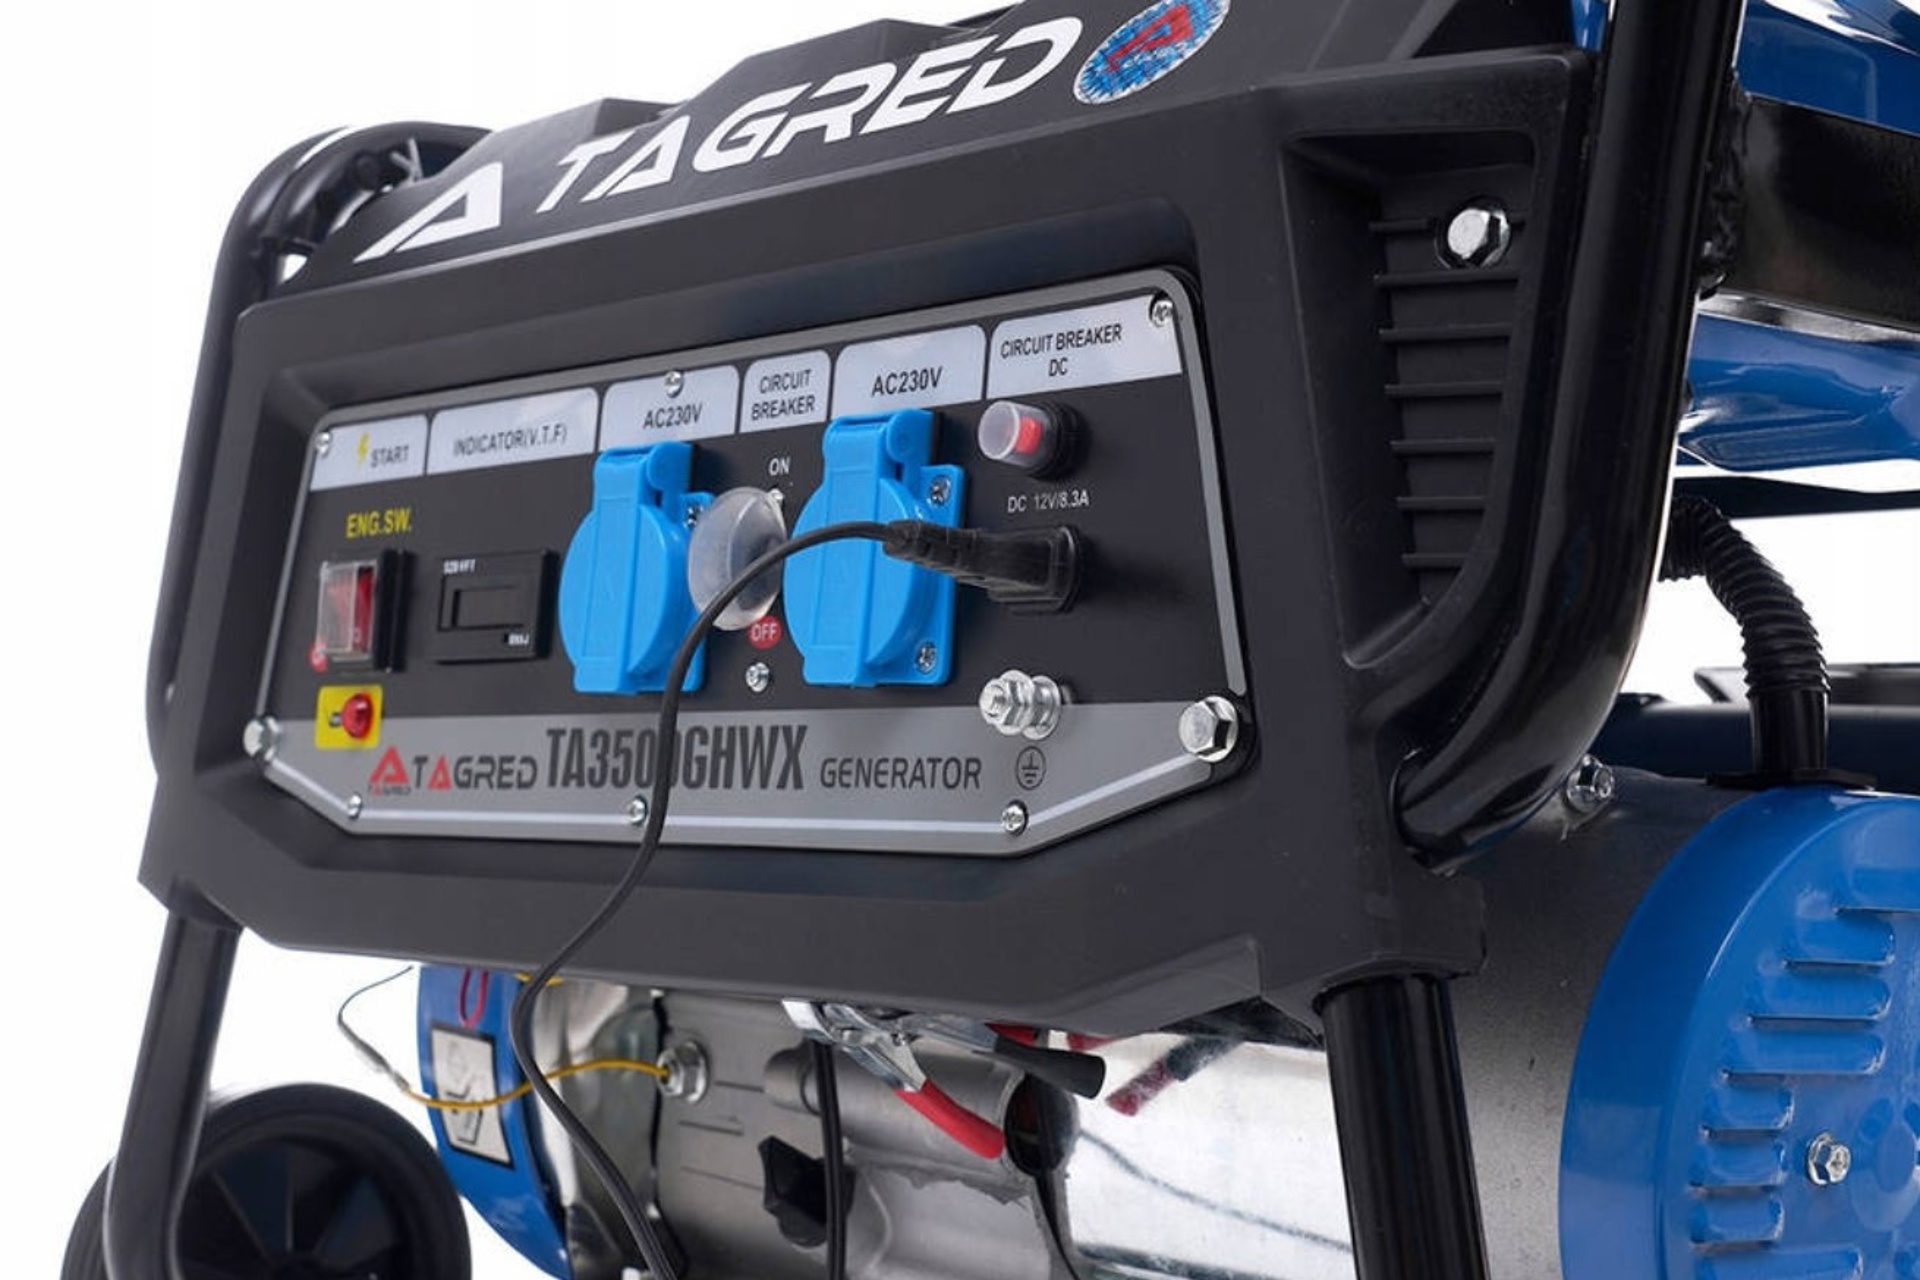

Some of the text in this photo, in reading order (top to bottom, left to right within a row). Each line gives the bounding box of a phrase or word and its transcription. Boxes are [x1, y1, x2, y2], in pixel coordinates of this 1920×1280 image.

[536, 16, 1083, 213] TAGRED
[1001, 323, 1122, 358] CIRCUIT BREAKER
[1048, 357, 1069, 377] DC
[759, 369, 812, 394] CIRCUIT
[871, 366, 943, 397] AC230V
[643, 404, 702, 430] AC230V
[751, 395, 816, 421] BREAKER
[370, 445, 409, 468] START
[768, 457, 791, 476] ON
[1007, 489, 1090, 513] DC 12V/8.3A
[345, 508, 412, 539] ENG.SW.
[750, 622, 778, 642] OFF
[413, 754, 538, 790] TAGRED
[820, 757, 982, 790] GENERATOR
